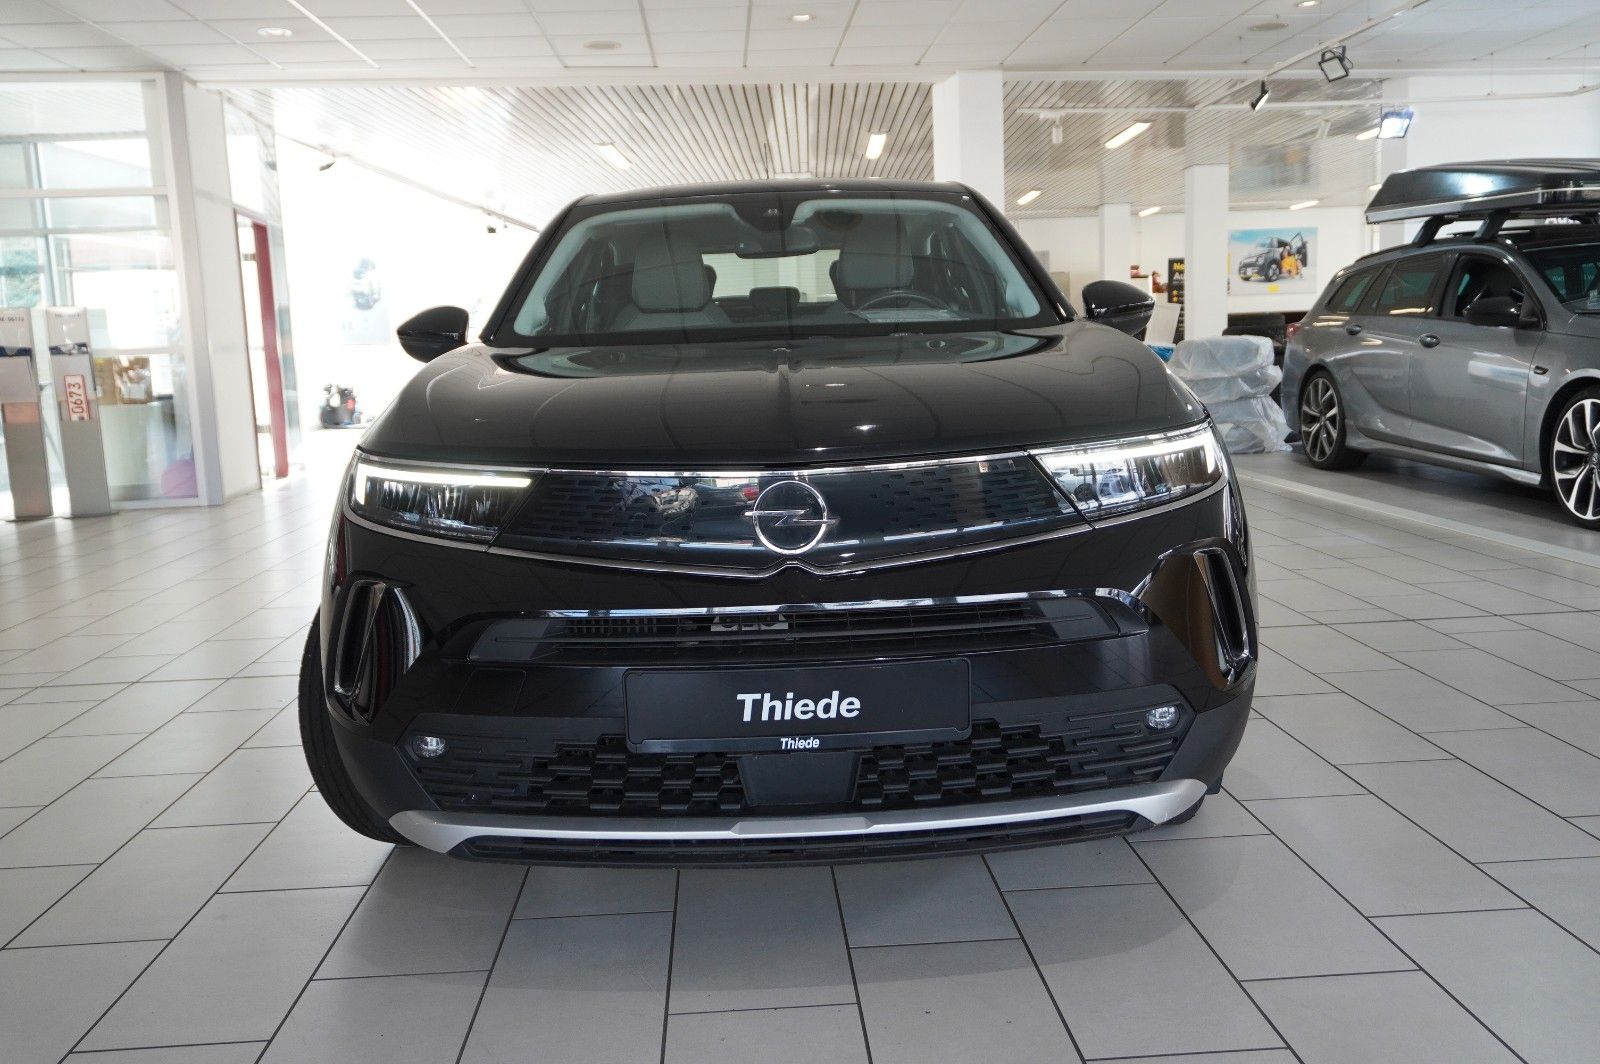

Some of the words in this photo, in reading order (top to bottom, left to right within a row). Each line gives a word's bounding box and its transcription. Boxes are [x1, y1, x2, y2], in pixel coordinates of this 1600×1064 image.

[68, 382, 85, 415] 0673
[736, 690, 861, 722] Thiede
[780, 736, 820, 749] Thiede
